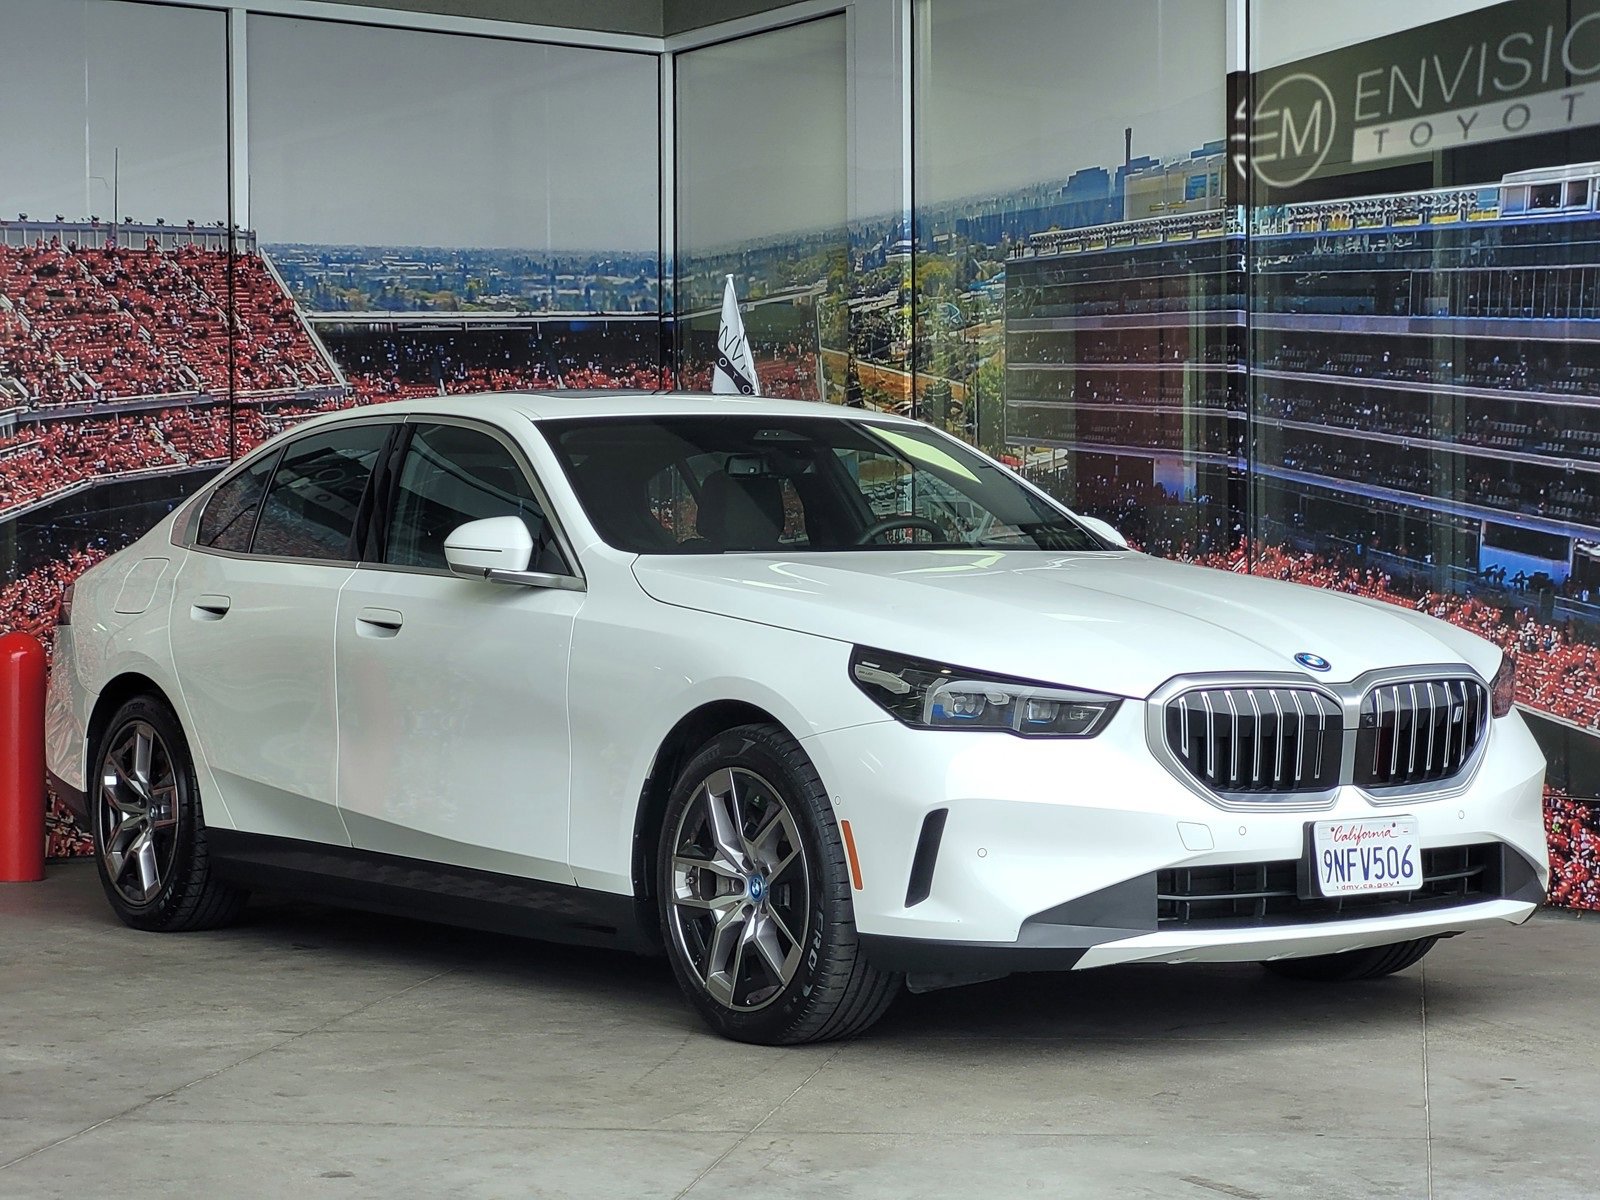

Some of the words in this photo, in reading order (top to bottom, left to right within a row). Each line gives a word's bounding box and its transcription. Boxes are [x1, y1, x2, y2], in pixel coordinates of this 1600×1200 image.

[1333, 825, 1398, 846] California
[1324, 844, 1413, 883] 9NFV506
[1341, 881, 1395, 891] dmv.ca.gov
